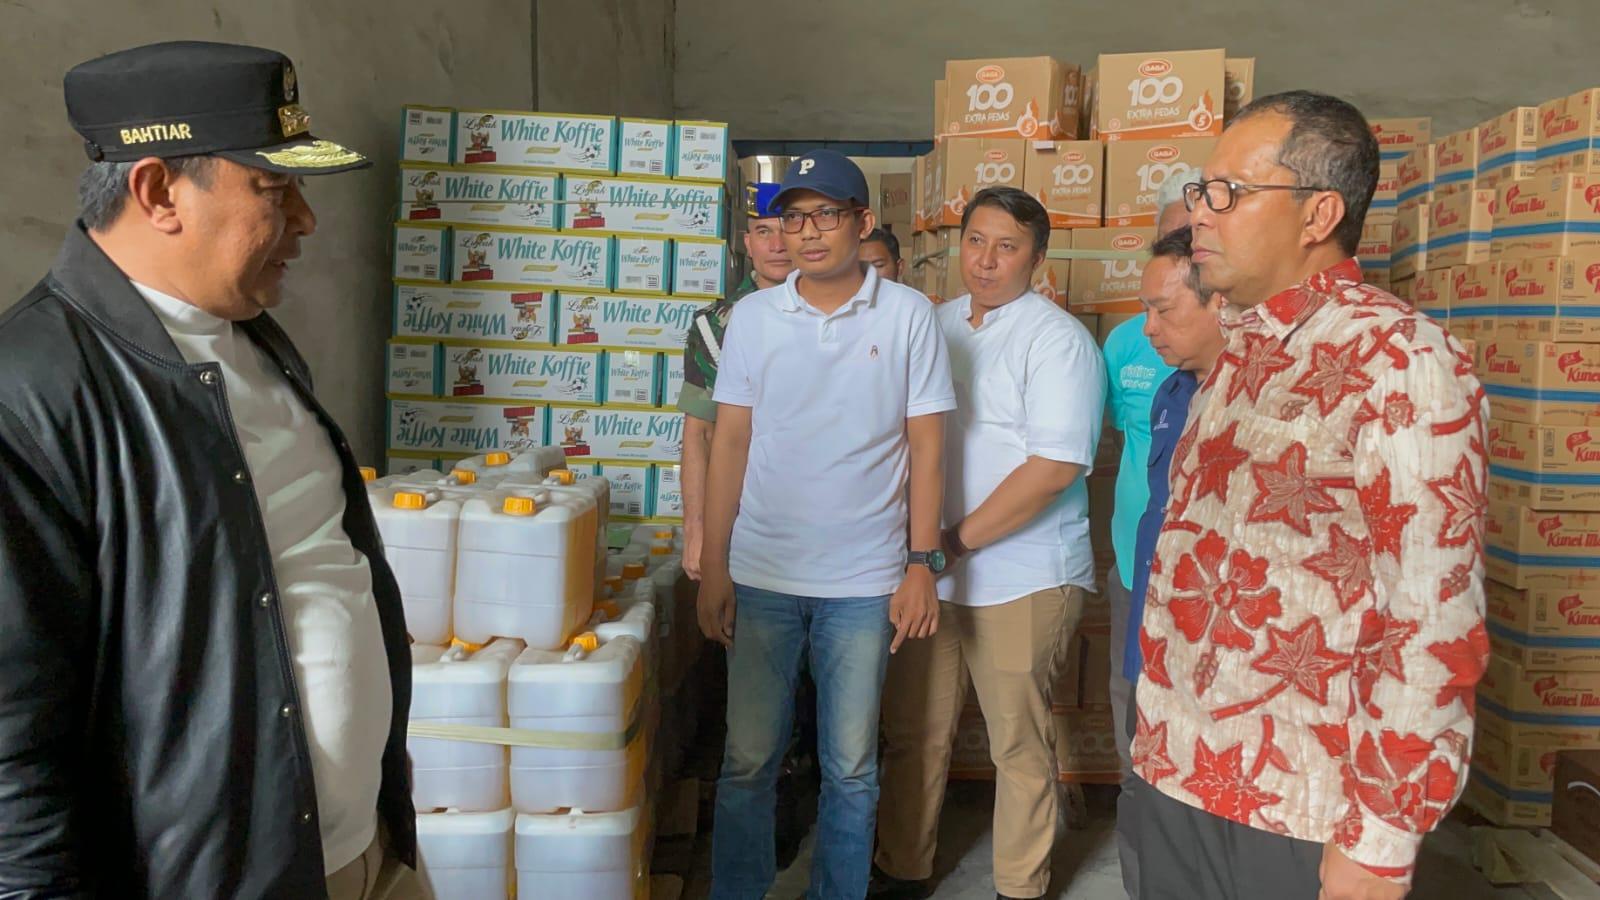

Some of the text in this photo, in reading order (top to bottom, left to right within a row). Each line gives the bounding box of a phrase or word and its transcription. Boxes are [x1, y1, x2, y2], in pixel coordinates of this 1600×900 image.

[966, 83, 1014, 112] 100
[1128, 76, 1183, 106] 100
[965, 112, 986, 124] EXTRA
[1126, 109, 1153, 120] EXTRA
[1198, 114, 1206, 127] 5
[120, 123, 192, 144] BAHTIAR
[501, 119, 550, 142] White
[553, 120, 604, 149] Koffie
[1025, 122, 1033, 133] 5
[798, 158, 816, 175] P
[974, 162, 1016, 184] 100
[1052, 164, 1094, 186] 100
[445, 176, 494, 199] White
[498, 178, 548, 206] Koffie
[608, 185, 658, 209] White
[662, 187, 714, 215] Koffie
[497, 236, 547, 260] White
[550, 237, 602, 267] Koffie
[621, 253, 661, 266] White Koffie
[679, 257, 719, 270] White Koffie
[403, 306, 507, 336] White Koffie
[603, 300, 651, 324] White
[488, 352, 537, 376] White
[540, 354, 591, 381] Koffie
[611, 367, 650, 379] White Koffie
[1567, 366, 1600, 383] Kunc
[396, 421, 499, 449] White Koffie
[594, 413, 642, 437] White
[609, 480, 643, 493] hite Koffie
[1546, 532, 1583, 548] Kunci
[1567, 610, 1600, 626] Kunc
[1542, 692, 1579, 708] Kunci
